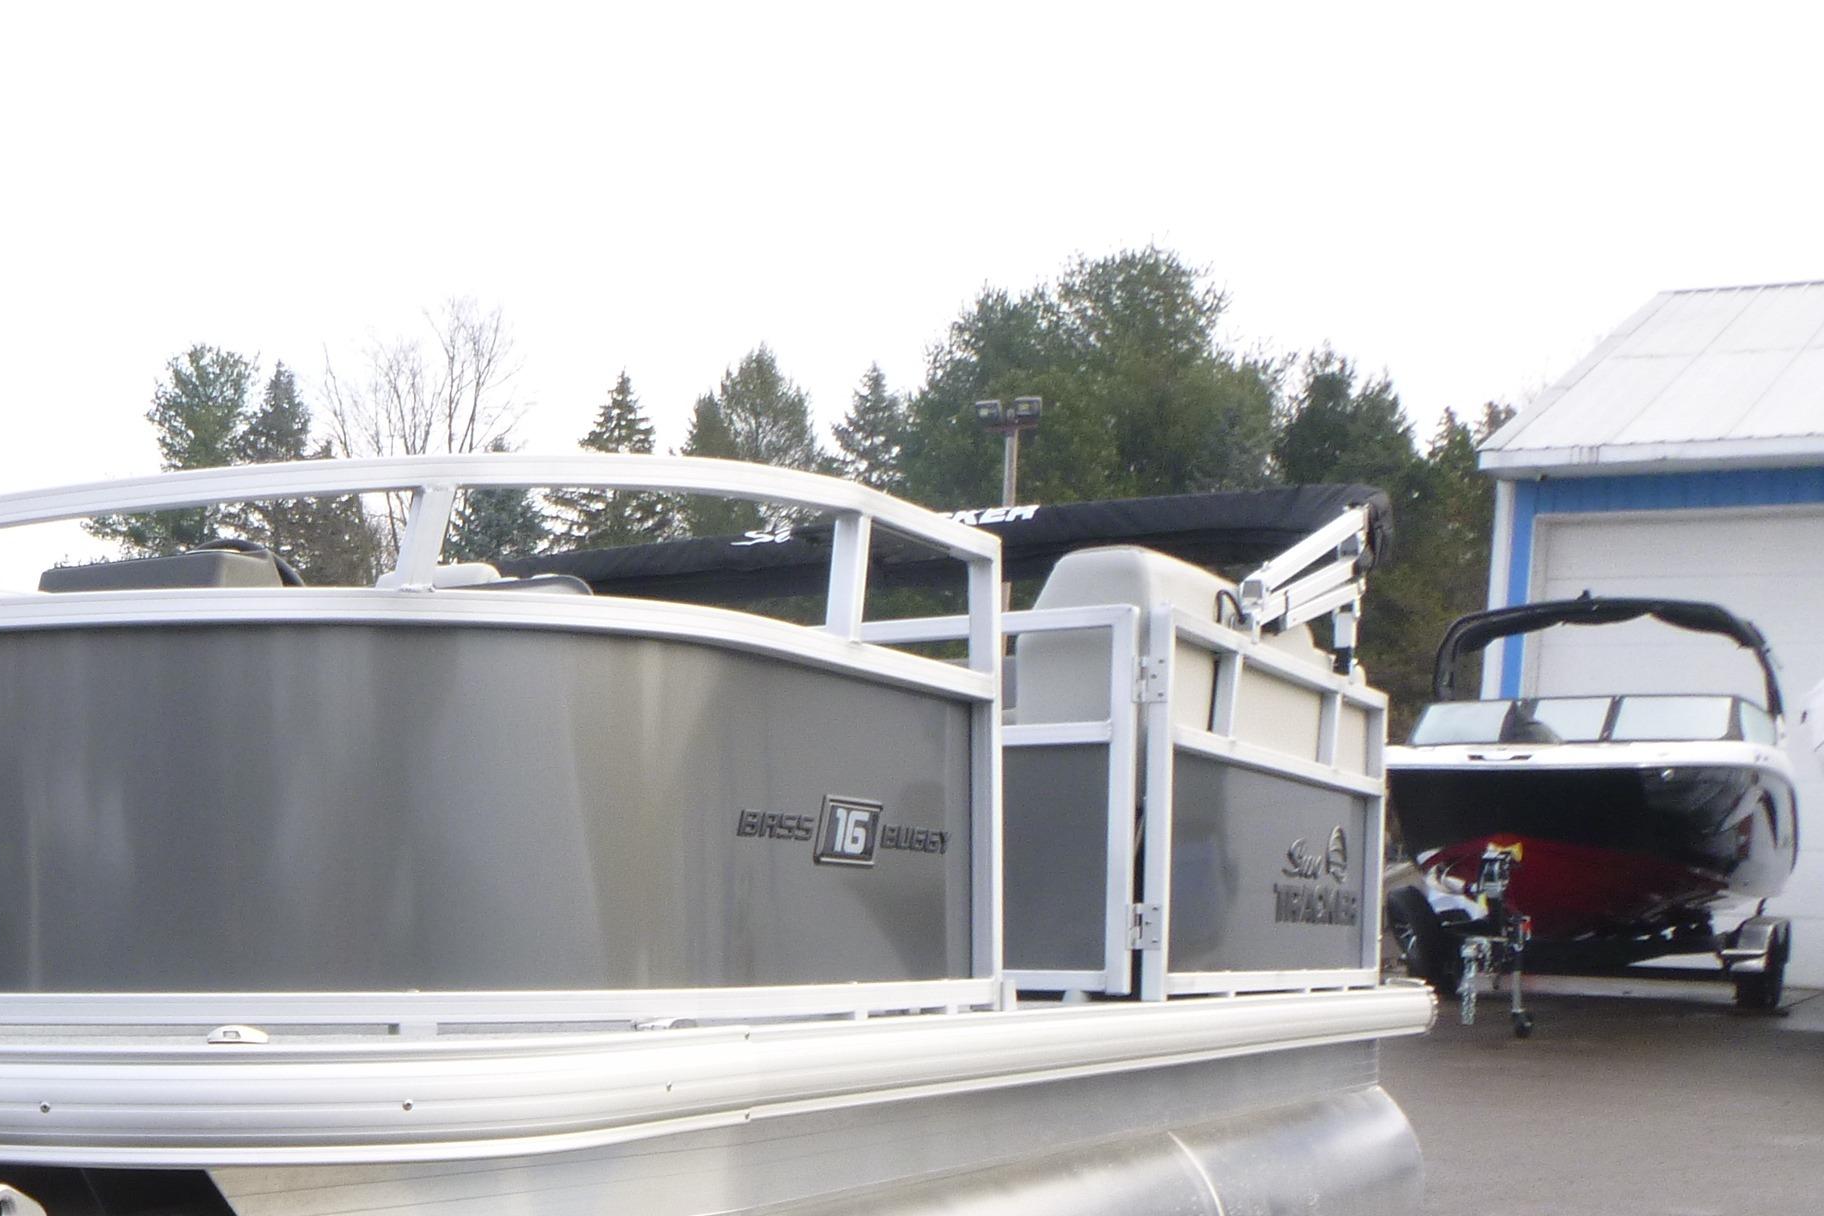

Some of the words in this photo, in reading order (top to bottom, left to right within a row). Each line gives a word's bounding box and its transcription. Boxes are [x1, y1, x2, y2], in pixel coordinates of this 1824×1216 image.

[736, 808, 815, 841] BASS
[832, 807, 871, 854] 16
[880, 824, 954, 854] BUGGY
